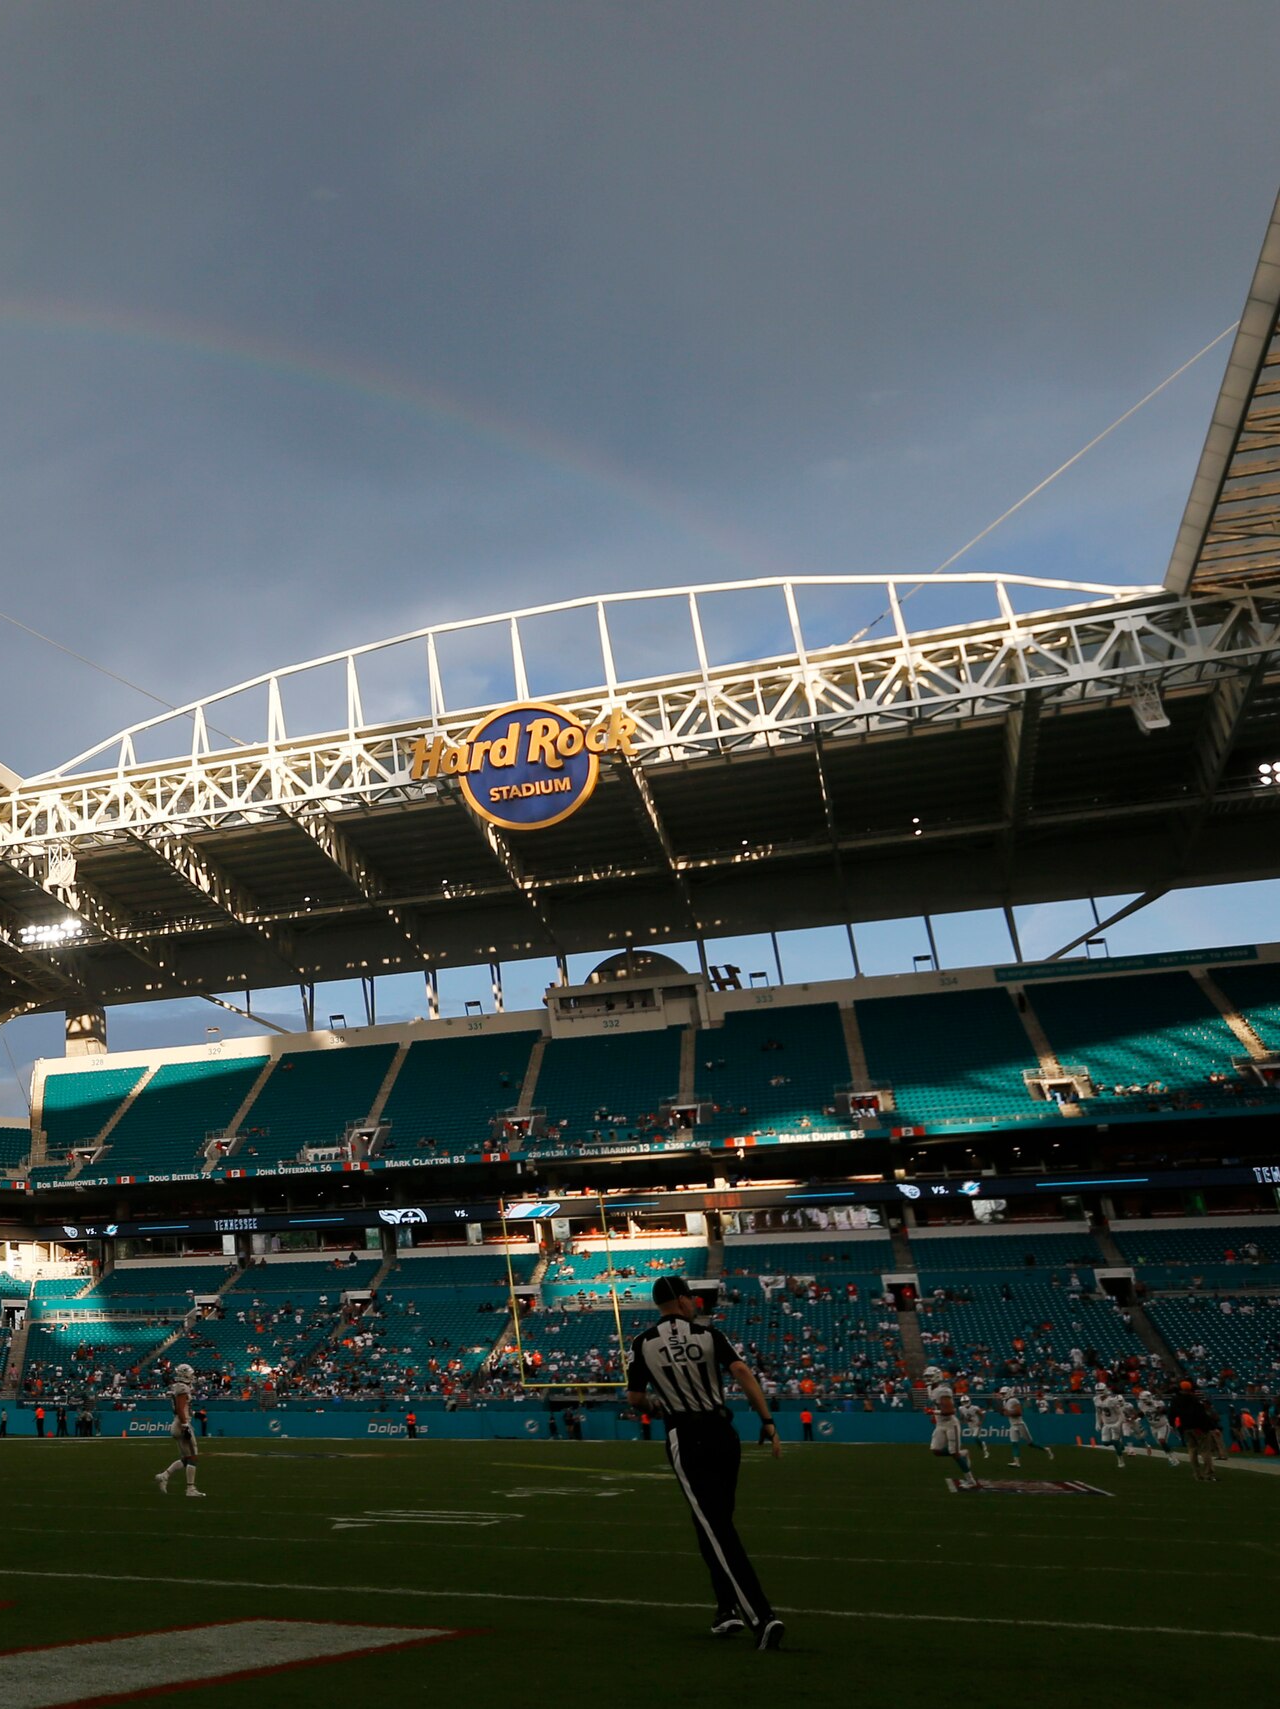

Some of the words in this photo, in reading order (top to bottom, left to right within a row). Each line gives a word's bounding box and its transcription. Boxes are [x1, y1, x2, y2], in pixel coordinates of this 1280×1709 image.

[410, 722, 521, 780] Hard
[525, 706, 639, 769] Rock
[489, 777, 572, 803] STADIUM
[467, 1022, 483, 1031] 331
[602, 1019, 620, 1028] 332
[328, 1035, 345, 1044] 330
[779, 1132, 810, 1142] MARK
[812, 1132, 846, 1141] DUPER
[850, 1130, 866, 1139] 85
[579, 1148, 598, 1156] DAN
[600, 1146, 637, 1156] MARINO
[639, 1144, 650, 1152] 13
[386, 1160, 410, 1168] MARK
[412, 1156, 450, 1166] CLAYTON
[453, 1155, 466, 1164] 83
[256, 1168, 276, 1176] JOHN
[278, 1166, 318, 1176] OFFERDAHL
[320, 1164, 332, 1172] 56
[148, 1174, 170, 1182] DOUG
[172, 1172, 199, 1182] BETTERS
[201, 1172, 212, 1180] 75
[36, 1181, 52, 1189] BOB
[53, 1180, 96, 1188] BAUMHOWER
[214, 1218, 258, 1231] TENNESSEE
[668, 1336, 687, 1346] SJ
[659, 1345, 703, 1363] 120
